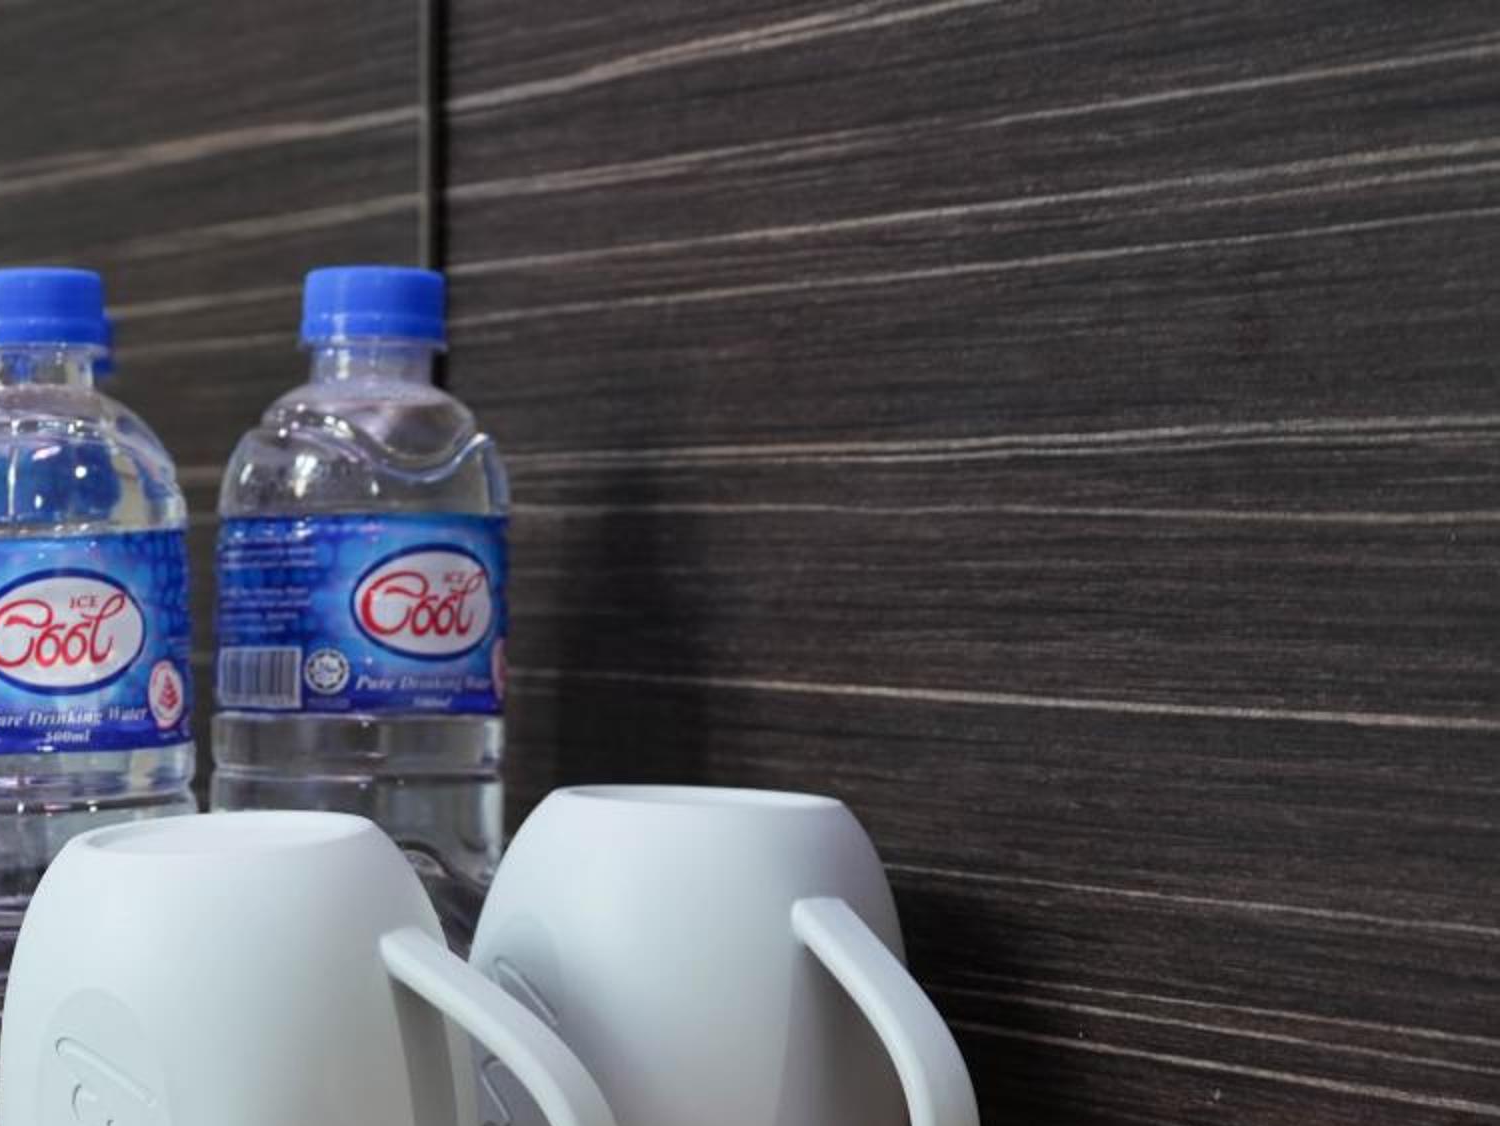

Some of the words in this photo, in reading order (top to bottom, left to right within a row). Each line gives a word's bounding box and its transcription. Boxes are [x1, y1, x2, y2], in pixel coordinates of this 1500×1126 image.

[69, 595, 99, 608] ICE
[360, 569, 485, 637] Cool
[28, 706, 102, 727] Drinking
[108, 706, 148, 721] Water
[45, 729, 91, 743] 500ml
